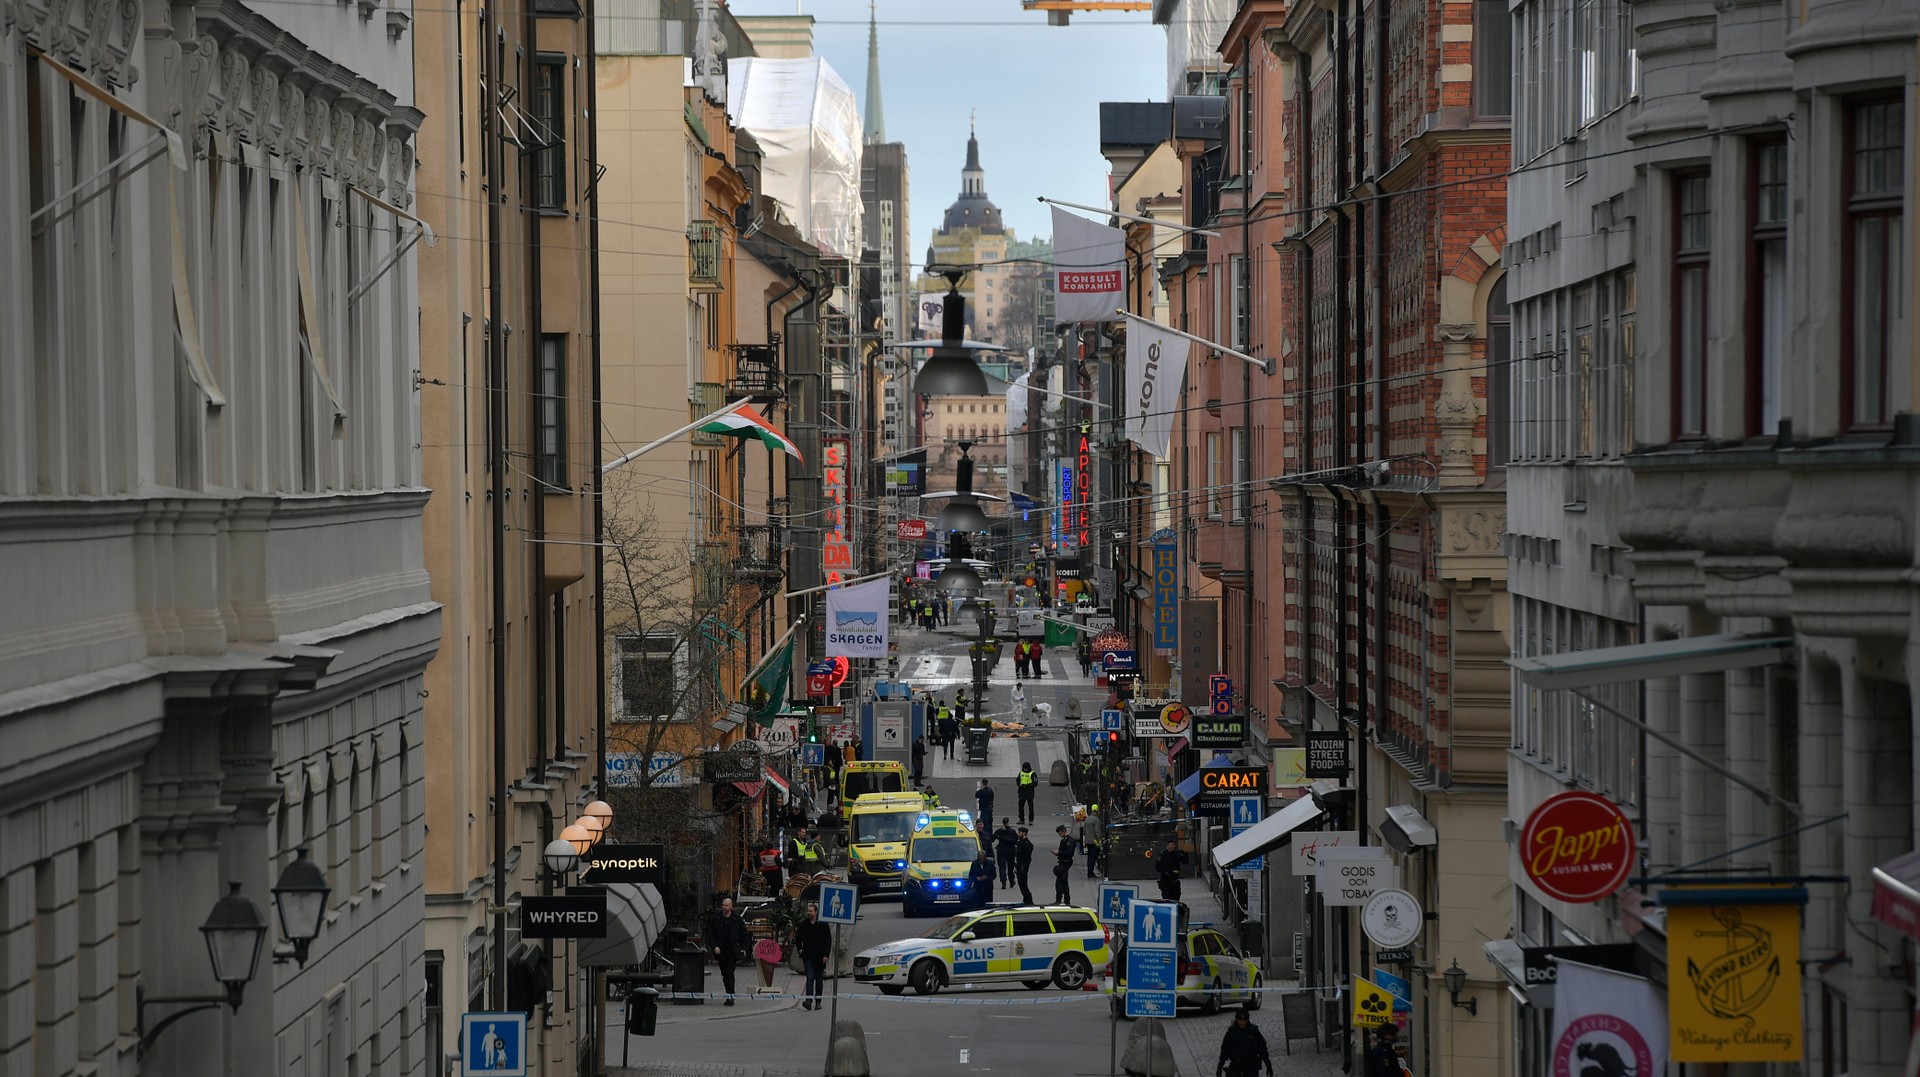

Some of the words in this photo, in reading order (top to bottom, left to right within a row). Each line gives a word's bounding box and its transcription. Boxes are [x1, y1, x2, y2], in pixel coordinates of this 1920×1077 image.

[1063, 274, 1116, 283] KONSULT
[1079, 436, 1089, 546] APOTEK
[824, 545, 851, 565] DA
[1158, 550, 1175, 643] HOTEL
[830, 634, 883, 644] SKAGEN
[1216, 682, 1229, 714] PO
[1310, 740, 1344, 750] INDIAN
[1310, 750, 1344, 759] STREET
[1311, 760, 1333, 769] FOOD
[1203, 772, 1260, 788] CARAT
[1532, 816, 1622, 877] Jappi
[591, 857, 657, 870] synoptik
[1552, 865, 1581, 875] SUSHI
[1583, 864, 1590, 873] &
[1591, 863, 1614, 872] WOK
[1341, 867, 1375, 877] GODIS
[530, 911, 598, 923] WHYRED
[954, 948, 995, 962] POLIS
[1379, 950, 1409, 960] REDKEN
[1527, 967, 1557, 980] BoC
[1699, 959, 1736, 996] BEYOND
[1738, 941, 1769, 968] RETRO
[1365, 1014, 1390, 1023] TRISS
[1733, 1026, 1794, 1050] Clothing
